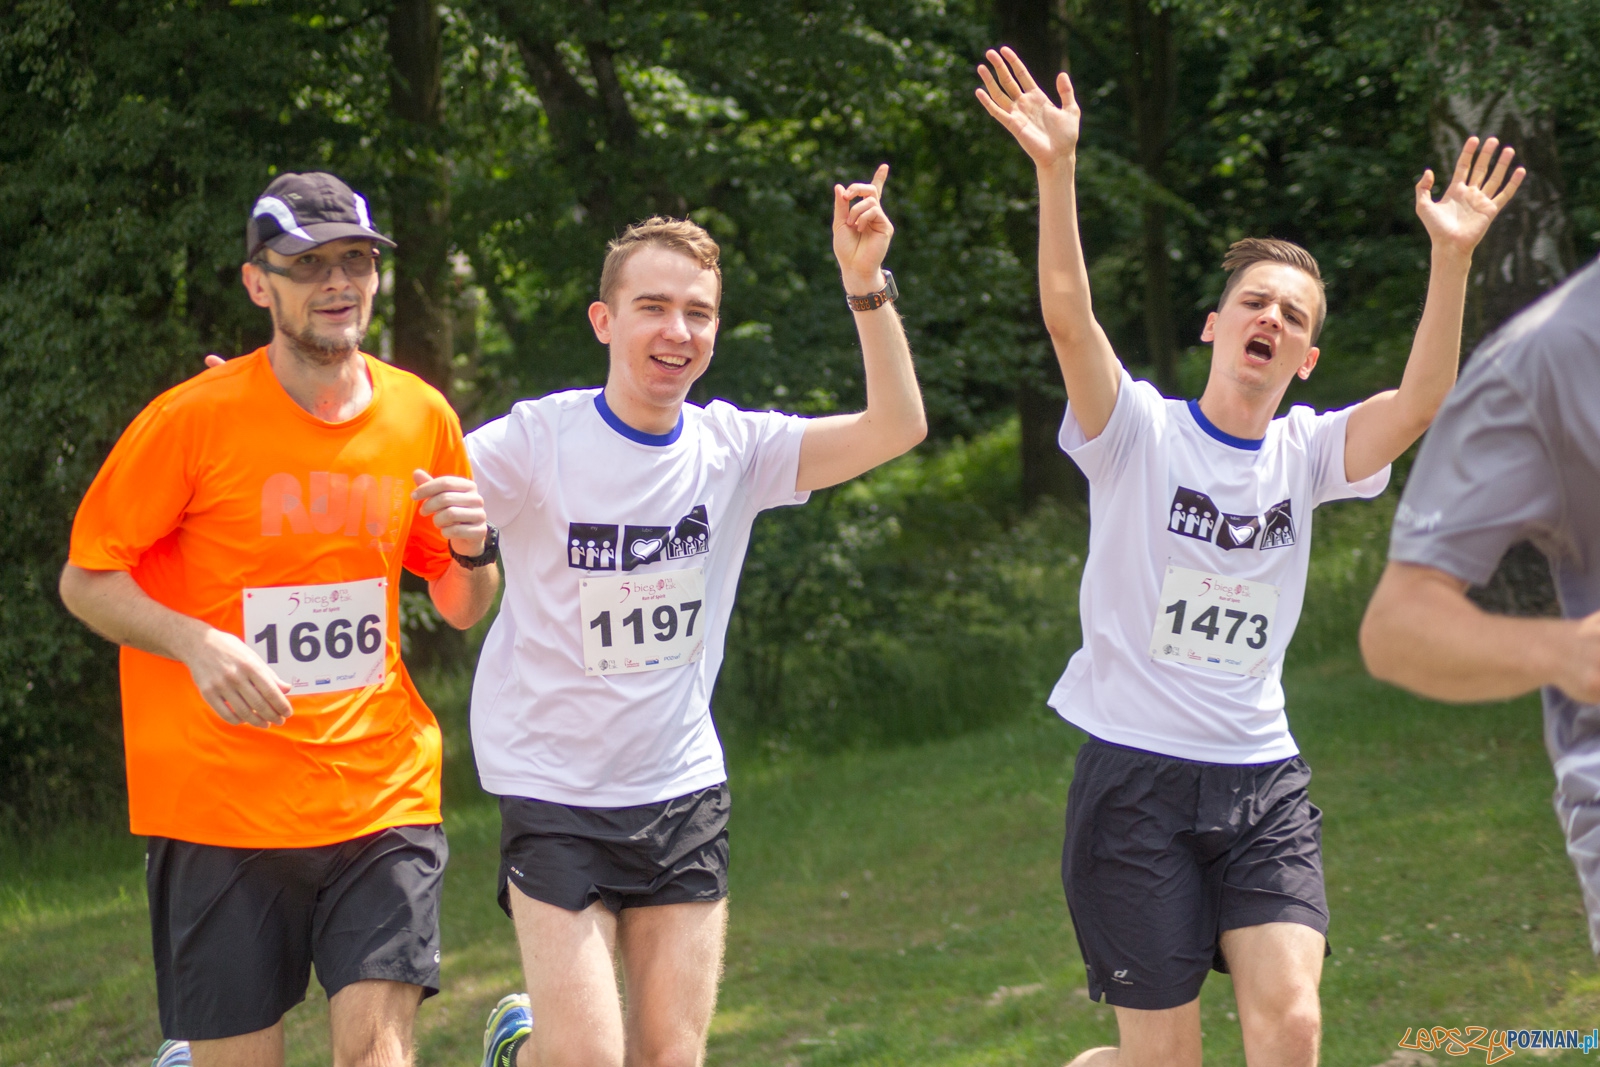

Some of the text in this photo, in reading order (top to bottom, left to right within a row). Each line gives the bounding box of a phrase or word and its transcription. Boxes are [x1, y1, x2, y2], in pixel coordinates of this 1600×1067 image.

[287, 591, 300, 616] 5
[304, 592, 329, 607] bieg
[619, 581, 631, 604] 5
[634, 581, 656, 595] bieg
[1198, 577, 1212, 597] 5
[1214, 580, 1234, 597] bieg
[254, 614, 382, 664] 1666
[590, 599, 702, 647] 1197
[1165, 599, 1268, 650] 1473
